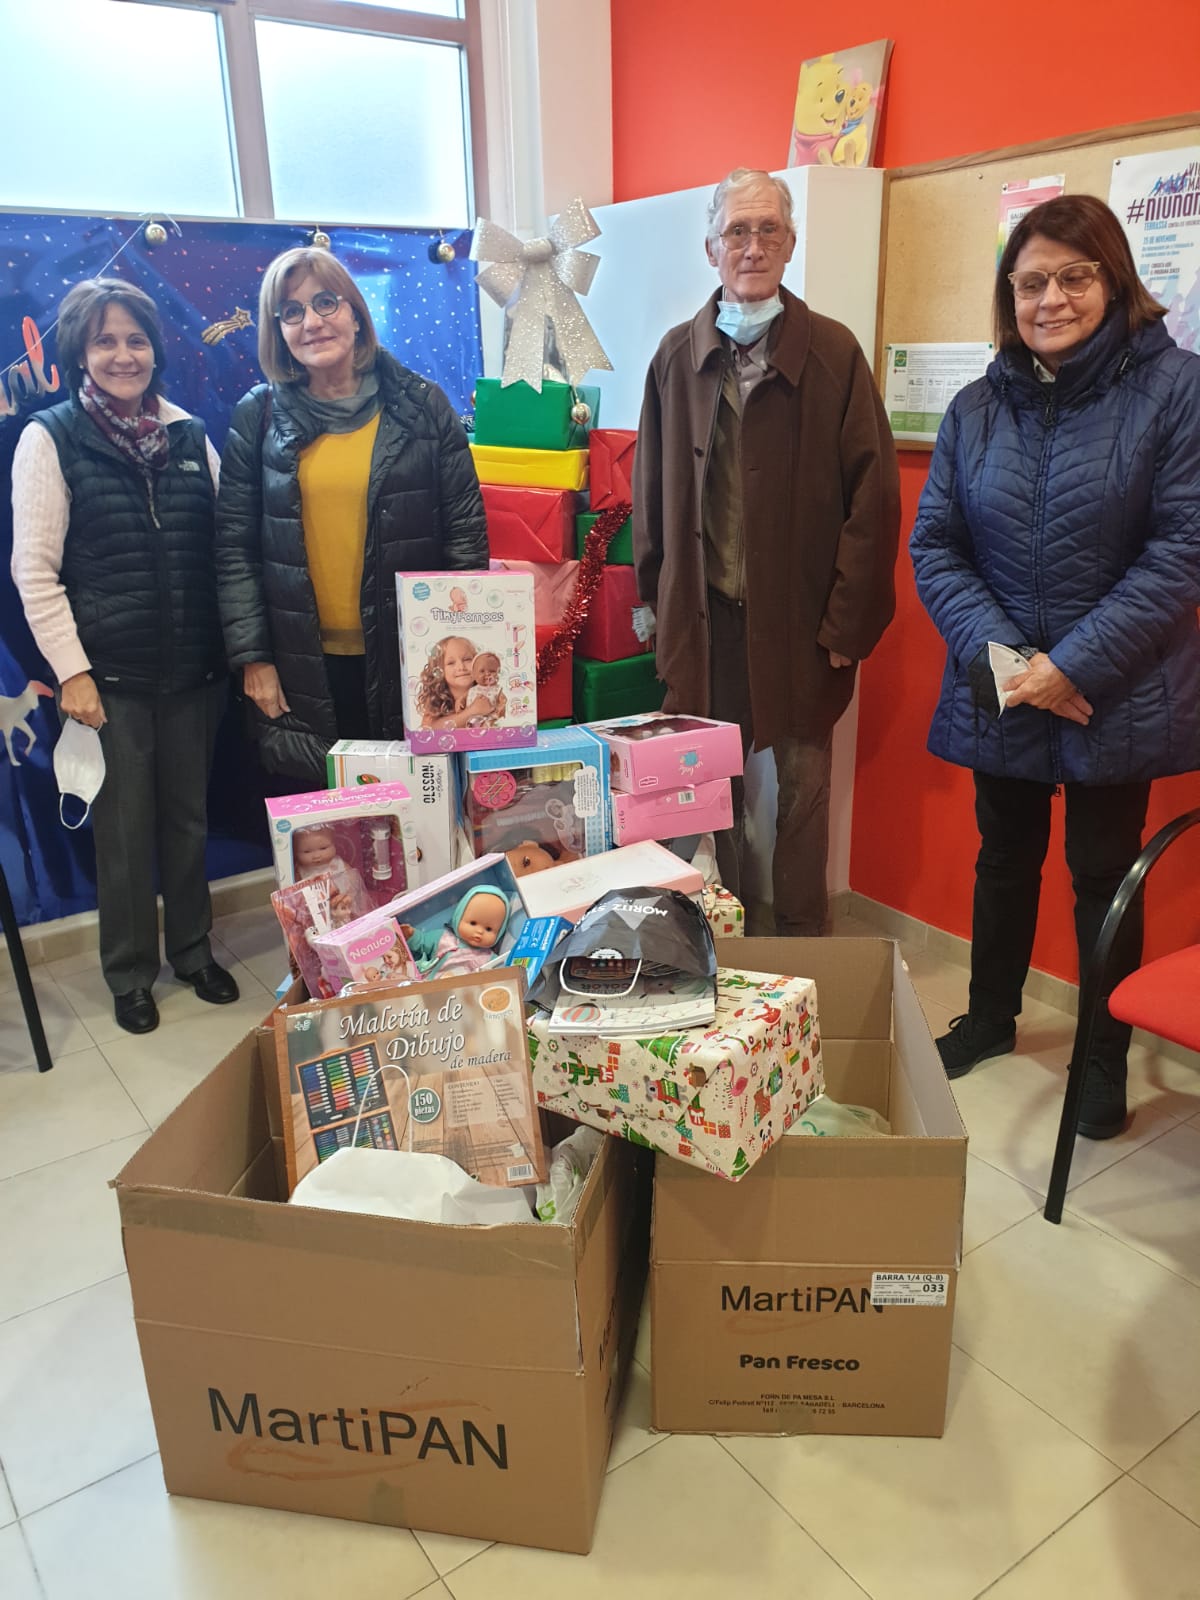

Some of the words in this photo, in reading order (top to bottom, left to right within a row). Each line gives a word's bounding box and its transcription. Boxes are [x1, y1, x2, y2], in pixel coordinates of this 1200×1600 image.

[612, 903, 668, 917] MORITZ
[350, 934, 392, 960] Nenuco
[339, 1003, 431, 1040] Maletín
[437, 995, 463, 1023] de
[386, 1029, 466, 1062] Dibujo
[450, 1054, 464, 1070] de
[468, 1049, 512, 1067] madera
[414, 1092, 433, 1107] 150
[922, 1283, 945, 1293] 033
[739, 1354, 781, 1370] Pan
[786, 1355, 860, 1371] Fresco
[207, 1387, 508, 1470] MartiPAN
